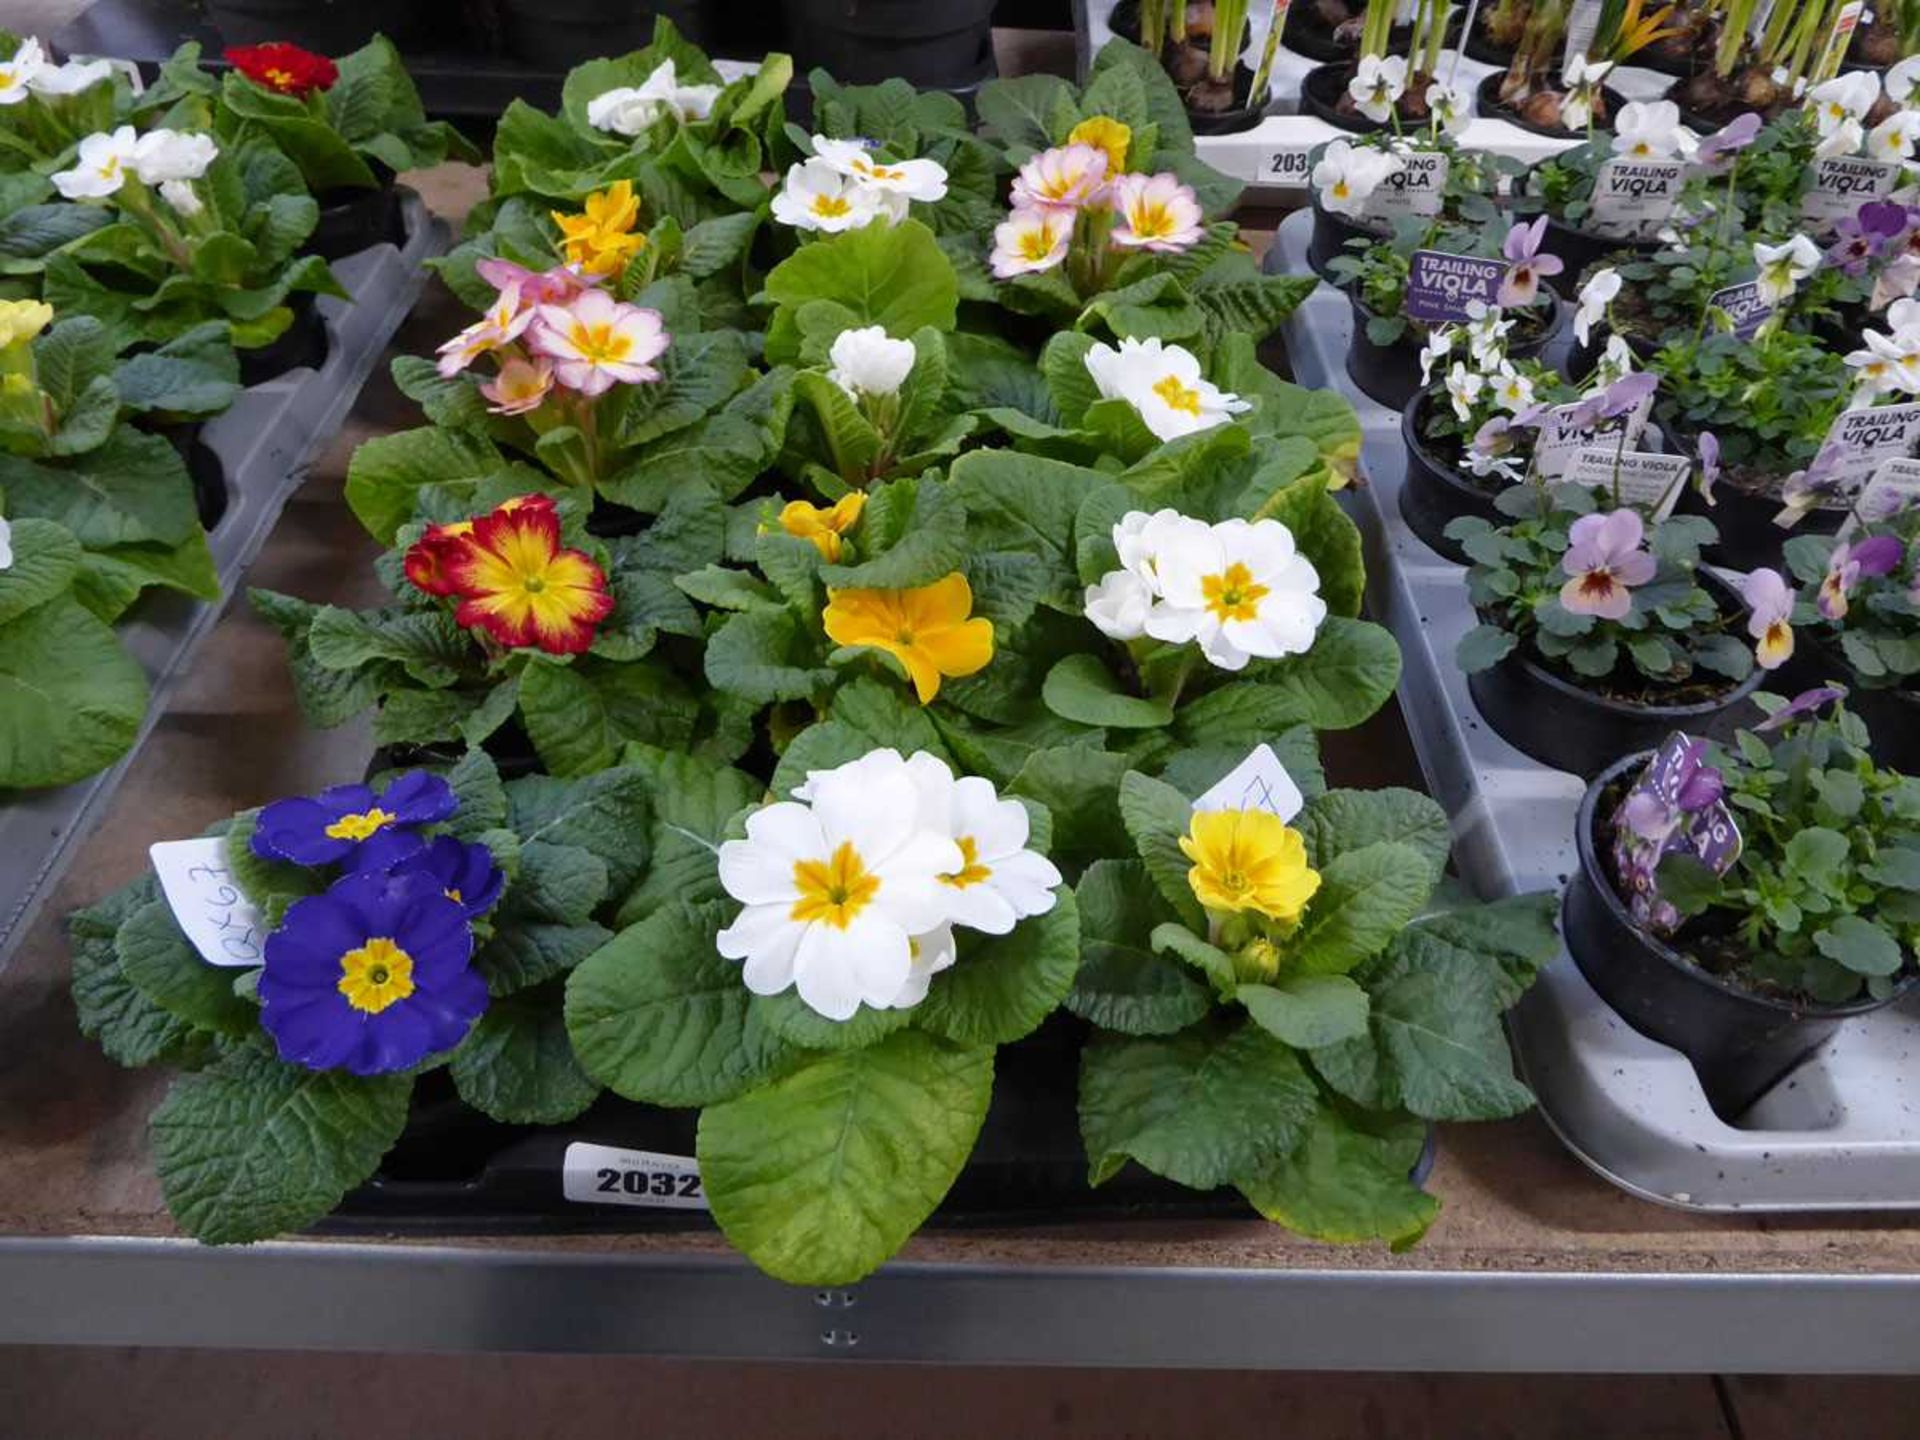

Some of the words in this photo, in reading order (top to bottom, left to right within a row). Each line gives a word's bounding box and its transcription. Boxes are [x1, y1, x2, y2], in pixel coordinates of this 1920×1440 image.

[1613, 165, 1678, 179] TRAILING
[1822, 160, 1888, 178] TRAILING
[1384, 171, 1430, 189] IOLA
[1611, 178, 1668, 196] VIOLA
[1818, 174, 1875, 193] VIOLA
[1420, 256, 1497, 280] TRAILING
[1420, 271, 1488, 296] VIOLA
[1846, 410, 1920, 429] TRAILING
[1843, 425, 1906, 447] VIOLA
[1641, 460, 1678, 472] VIOLA
[597, 1168, 700, 1198] 2032
